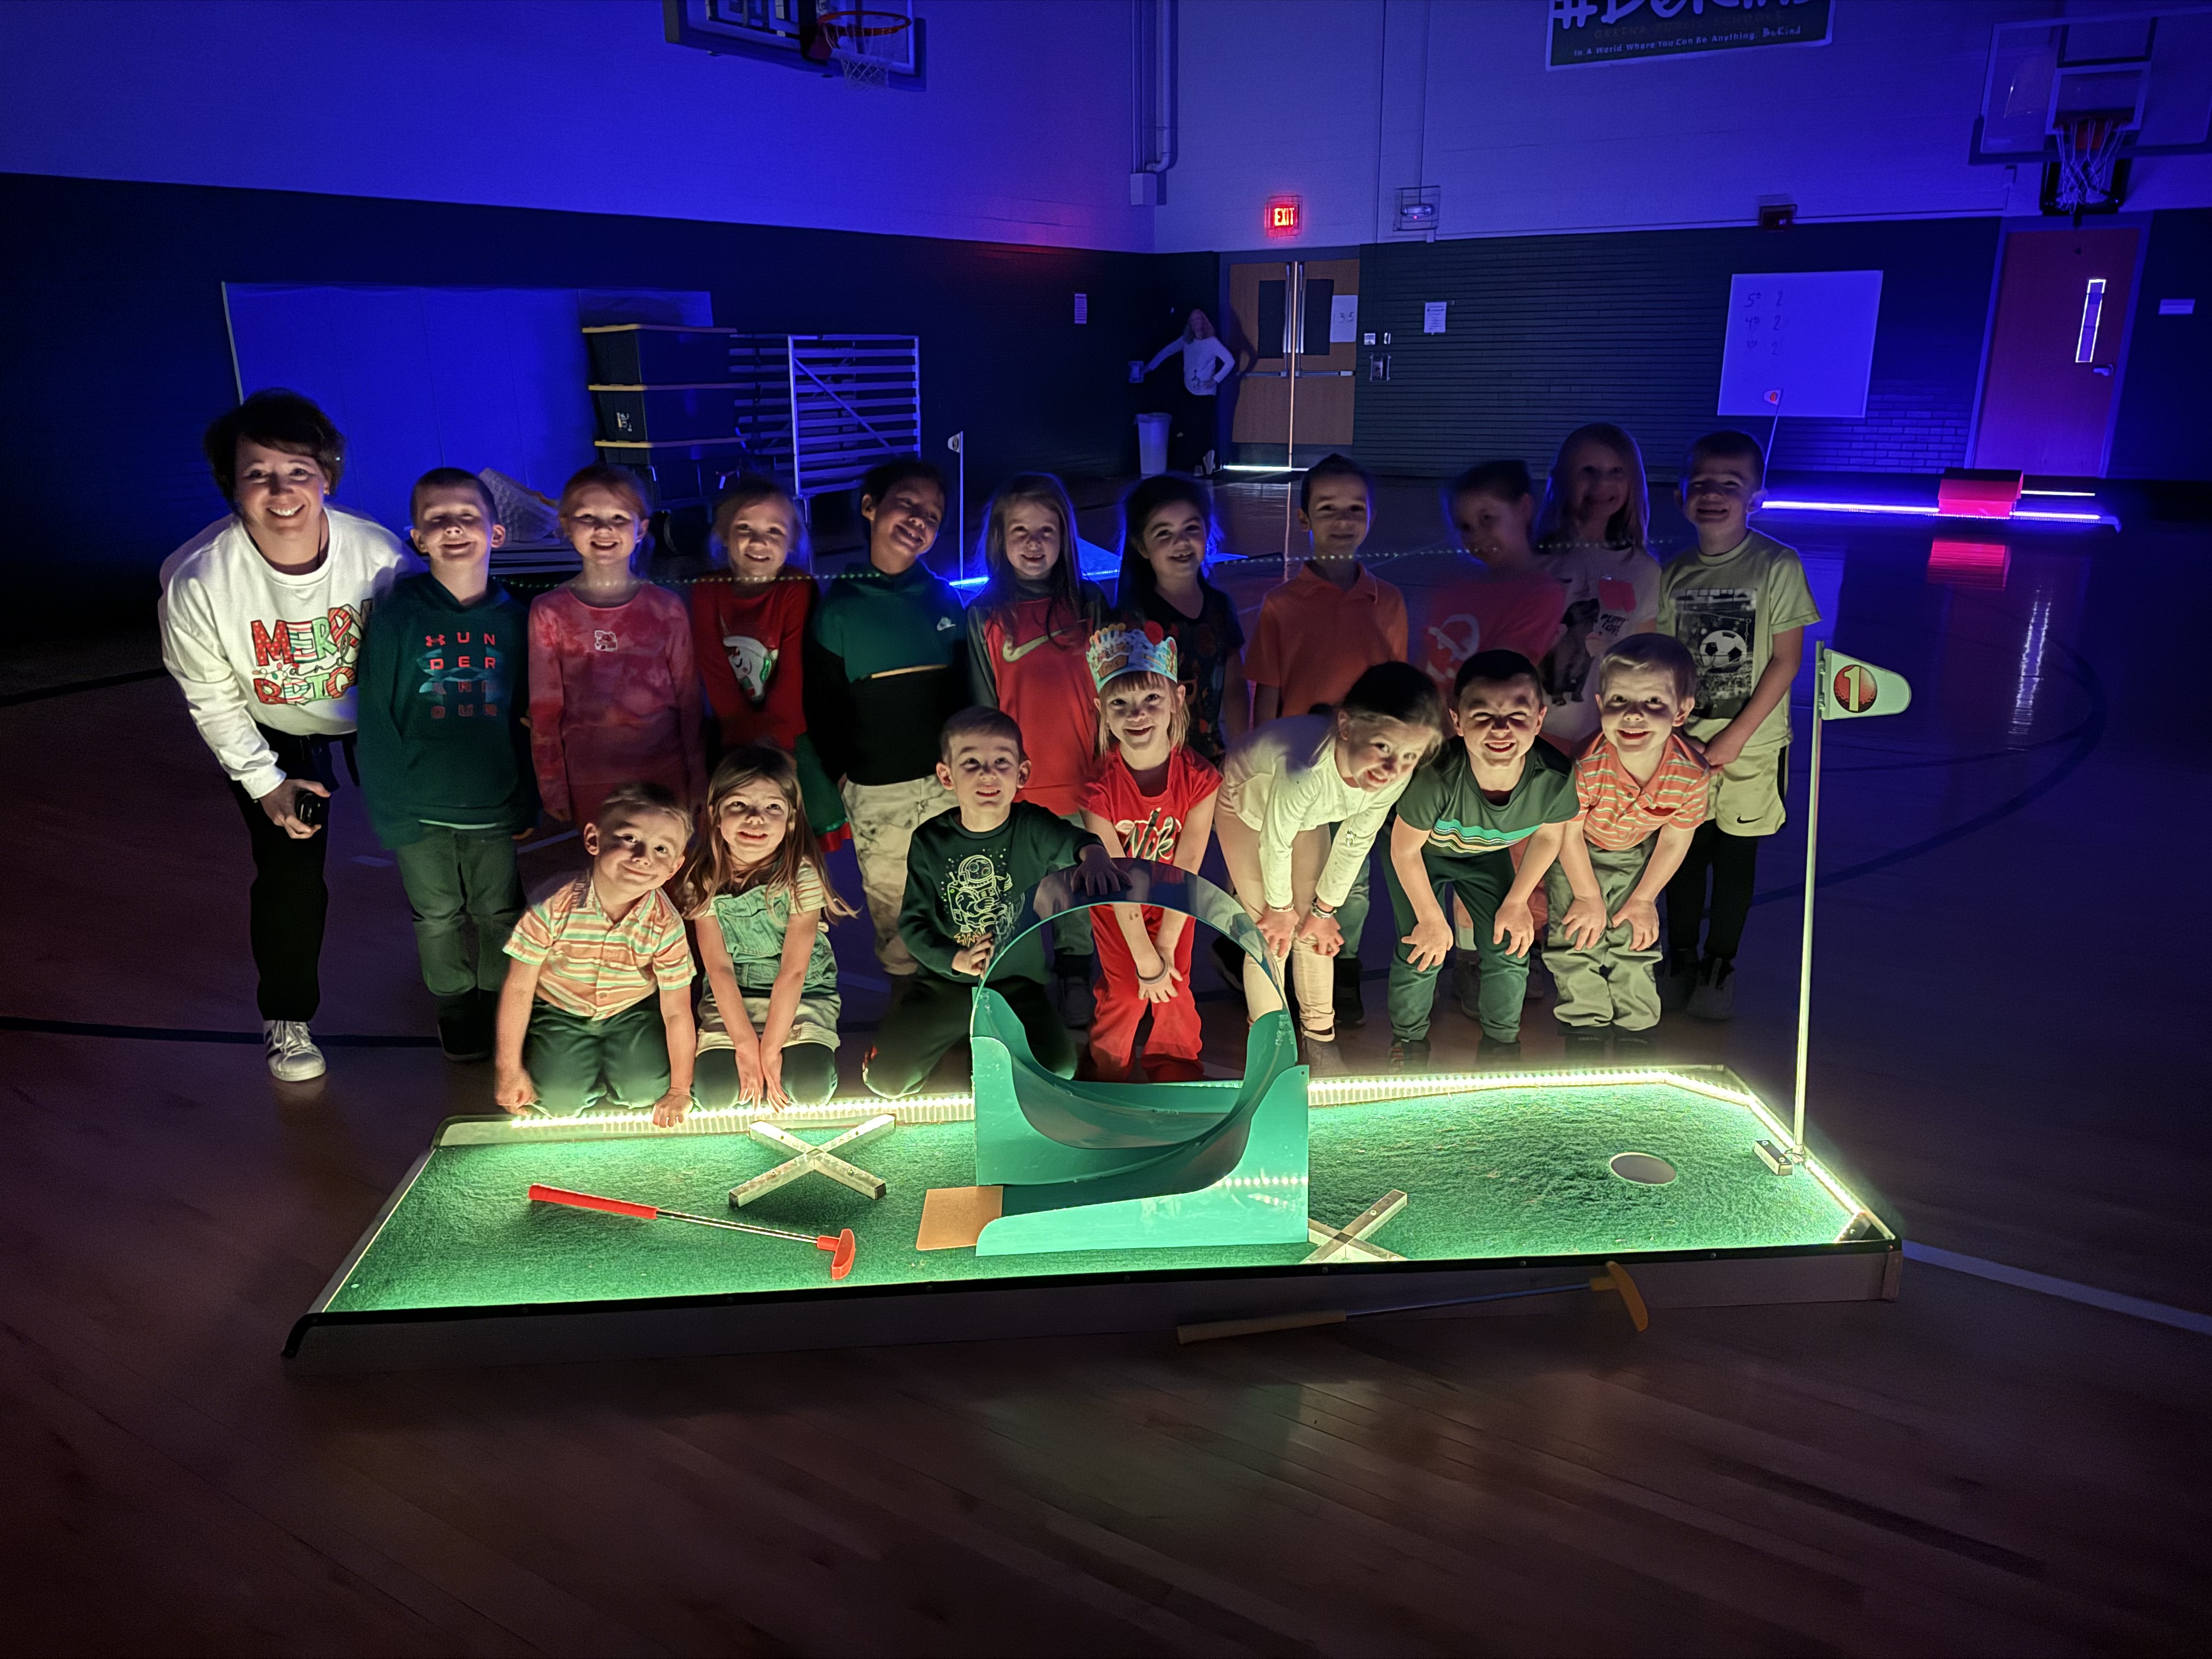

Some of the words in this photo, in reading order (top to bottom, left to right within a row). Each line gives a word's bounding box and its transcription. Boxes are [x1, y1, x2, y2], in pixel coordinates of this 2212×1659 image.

[1595, 44, 1622, 54] World
[1626, 42, 1656, 52] Where
[1675, 38, 1694, 46] Can
[1274, 207, 1295, 227] EXIT
[1773, 315, 1781, 331] 2
[1771, 341, 1778, 356] 2
[1601, 622, 1621, 636] LOVE
[430, 656, 496, 670] DER
[1843, 665, 1860, 712] 1
